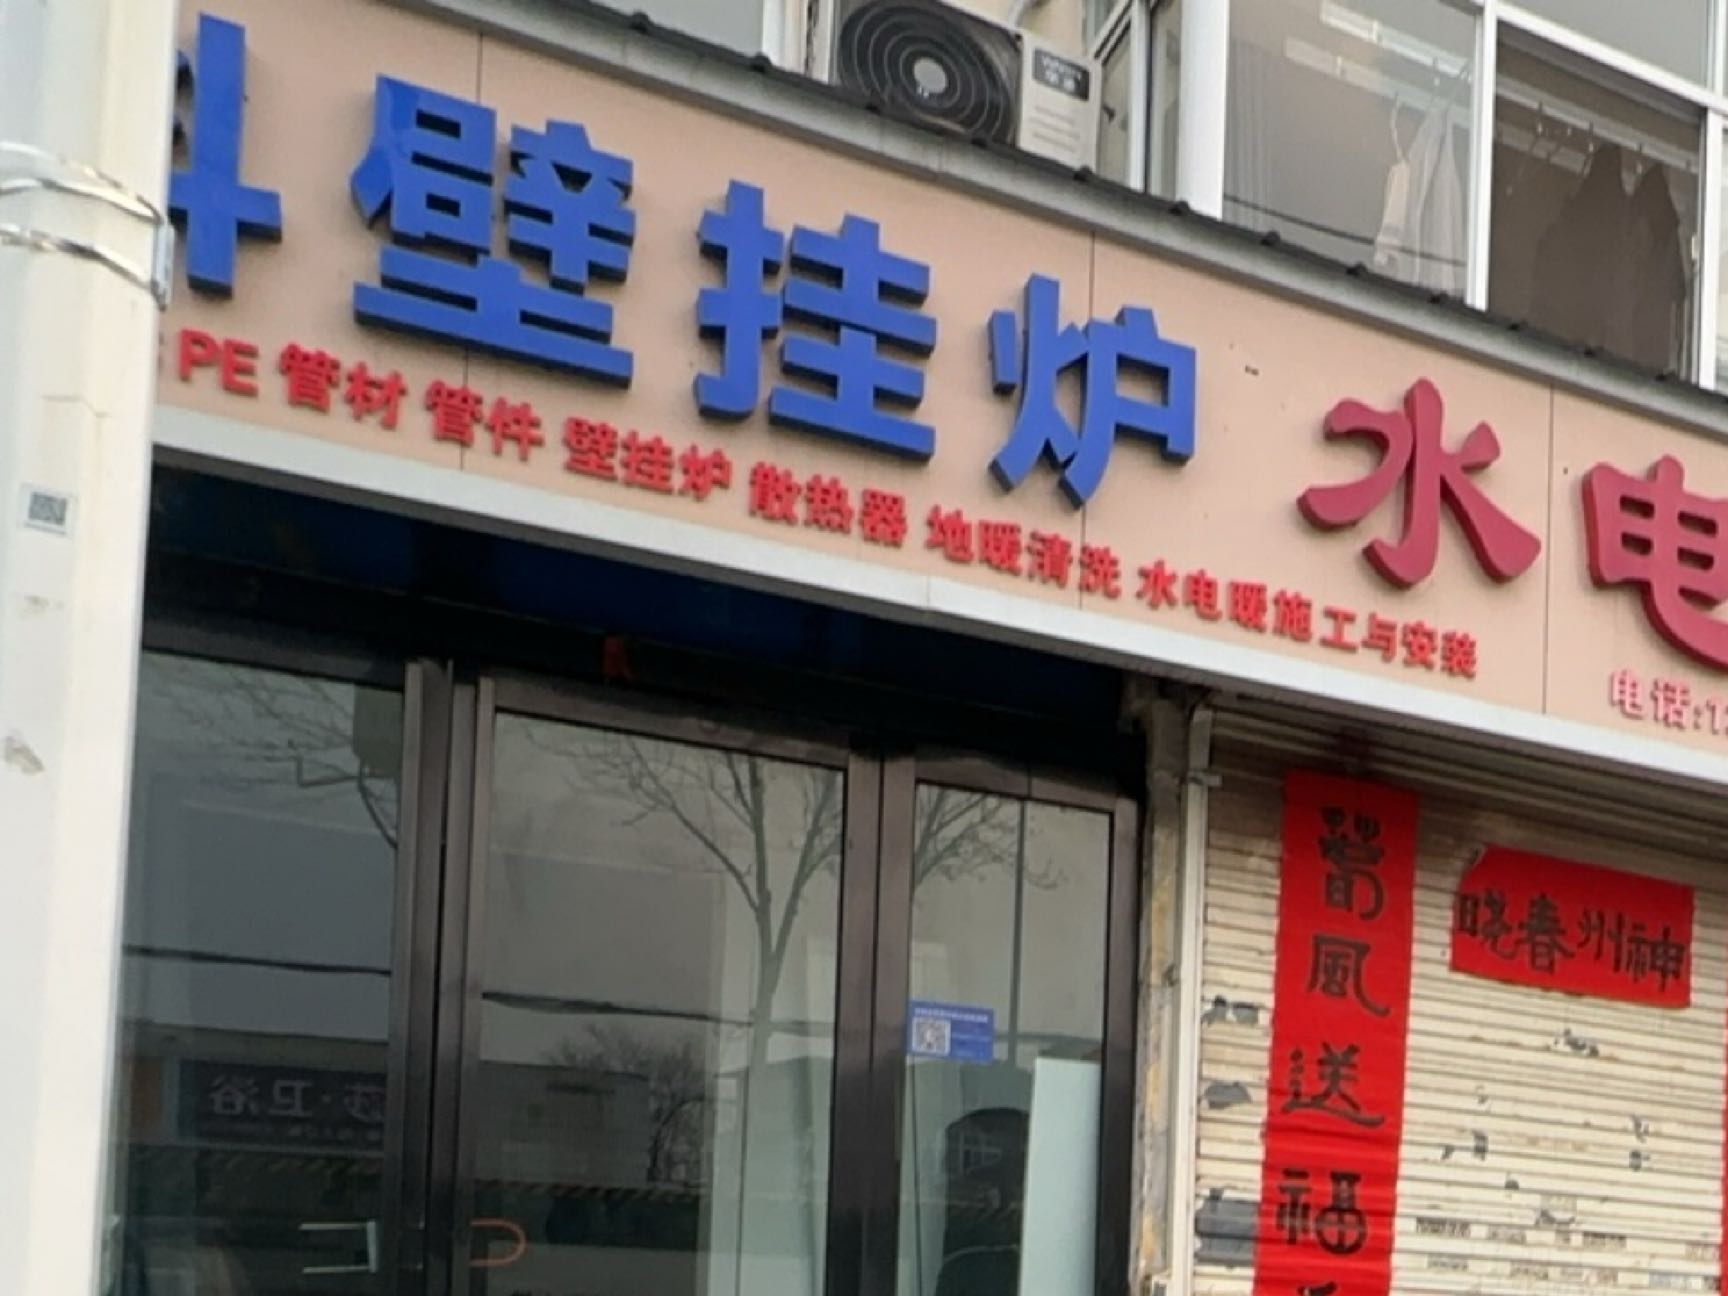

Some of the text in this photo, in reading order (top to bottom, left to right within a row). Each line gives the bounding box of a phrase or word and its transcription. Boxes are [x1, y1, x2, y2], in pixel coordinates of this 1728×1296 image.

[178, 328, 1478, 680] PE 管材 管件 壁挂炉 散热器 地暖清洗 水电暖施工与安装
